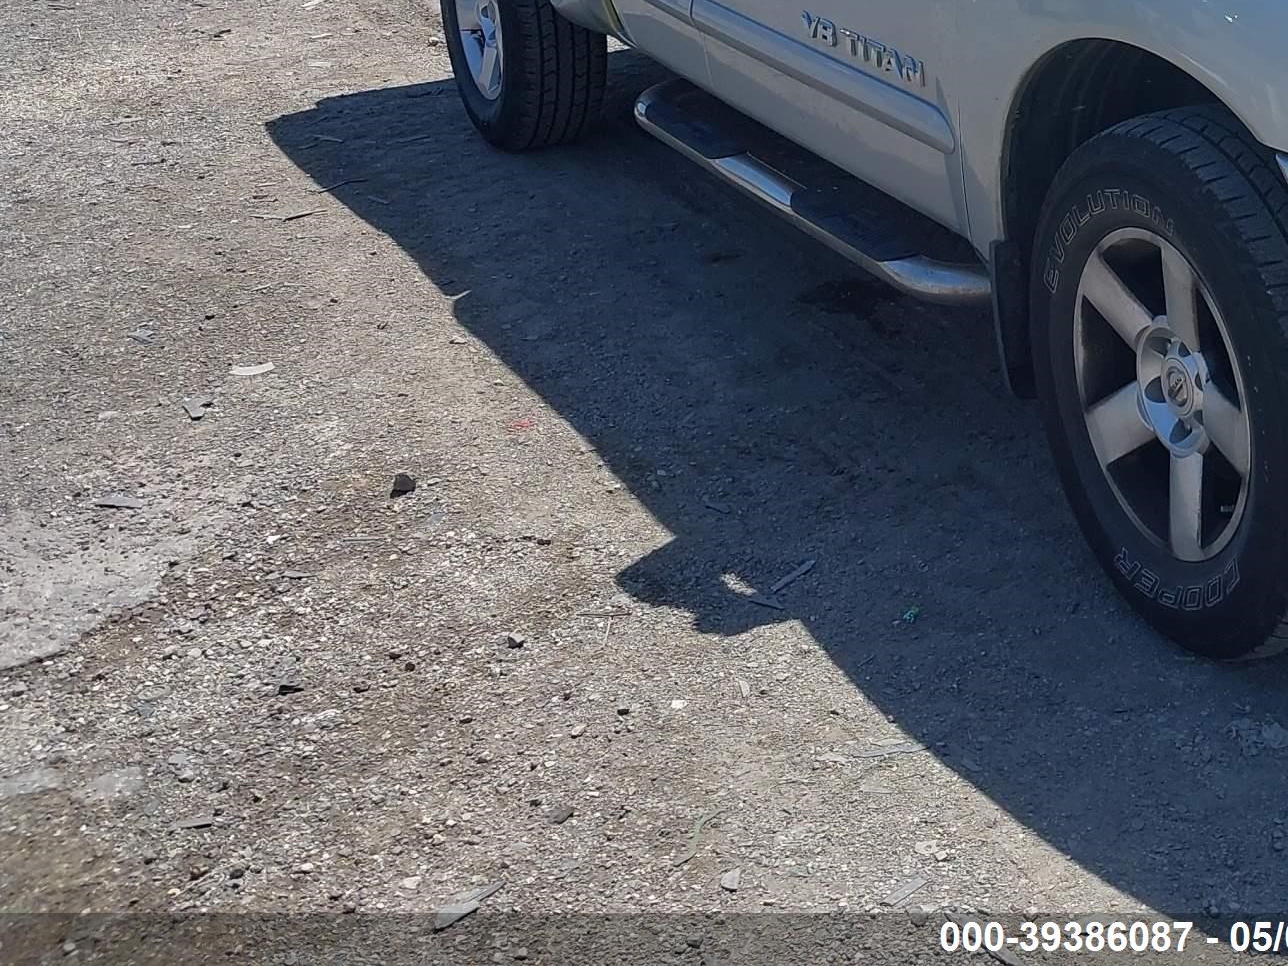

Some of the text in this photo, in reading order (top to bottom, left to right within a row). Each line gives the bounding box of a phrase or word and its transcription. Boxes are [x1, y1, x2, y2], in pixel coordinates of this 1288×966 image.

[801, 9, 926, 88] V8 TITAN
[1043, 188, 1175, 294] EVOLUTION
[1113, 545, 1241, 611] COOPER
